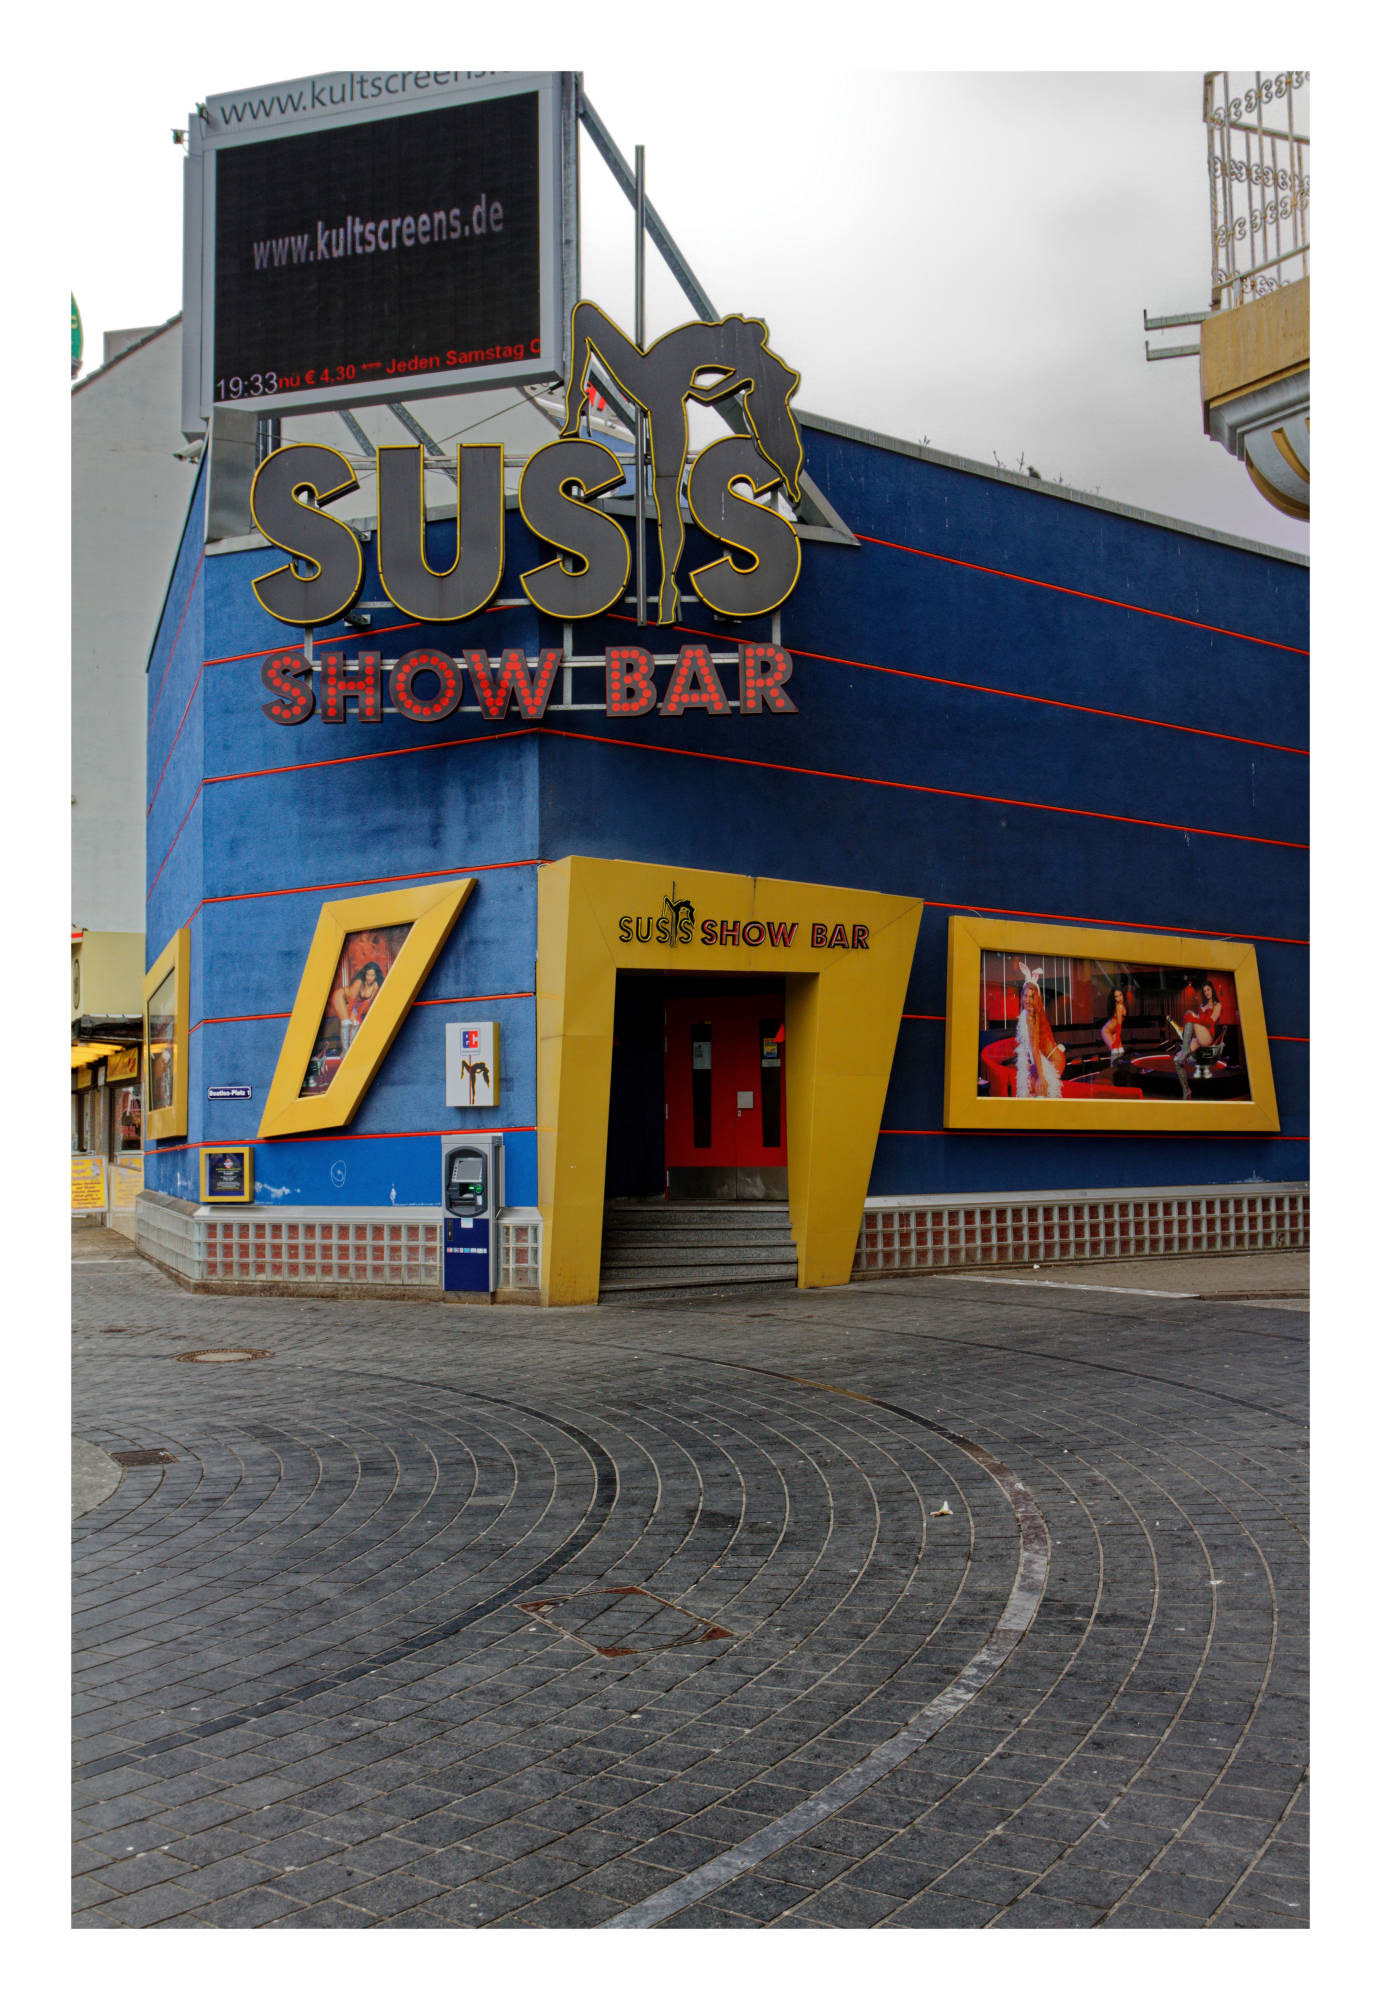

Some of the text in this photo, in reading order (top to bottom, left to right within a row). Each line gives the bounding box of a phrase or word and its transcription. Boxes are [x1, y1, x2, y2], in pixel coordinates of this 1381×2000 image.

[253, 193, 504, 270] www.kultscreens.de
[304, 368, 316, 385] €
[386, 355, 440, 374] Jeden
[446, 343, 525, 366] Samstag
[216, 371, 278, 400] 19:33
[261, 644, 799, 725] SHOW BAR
[701, 919, 799, 948] SHOW
[810, 923, 870, 950] BAR
